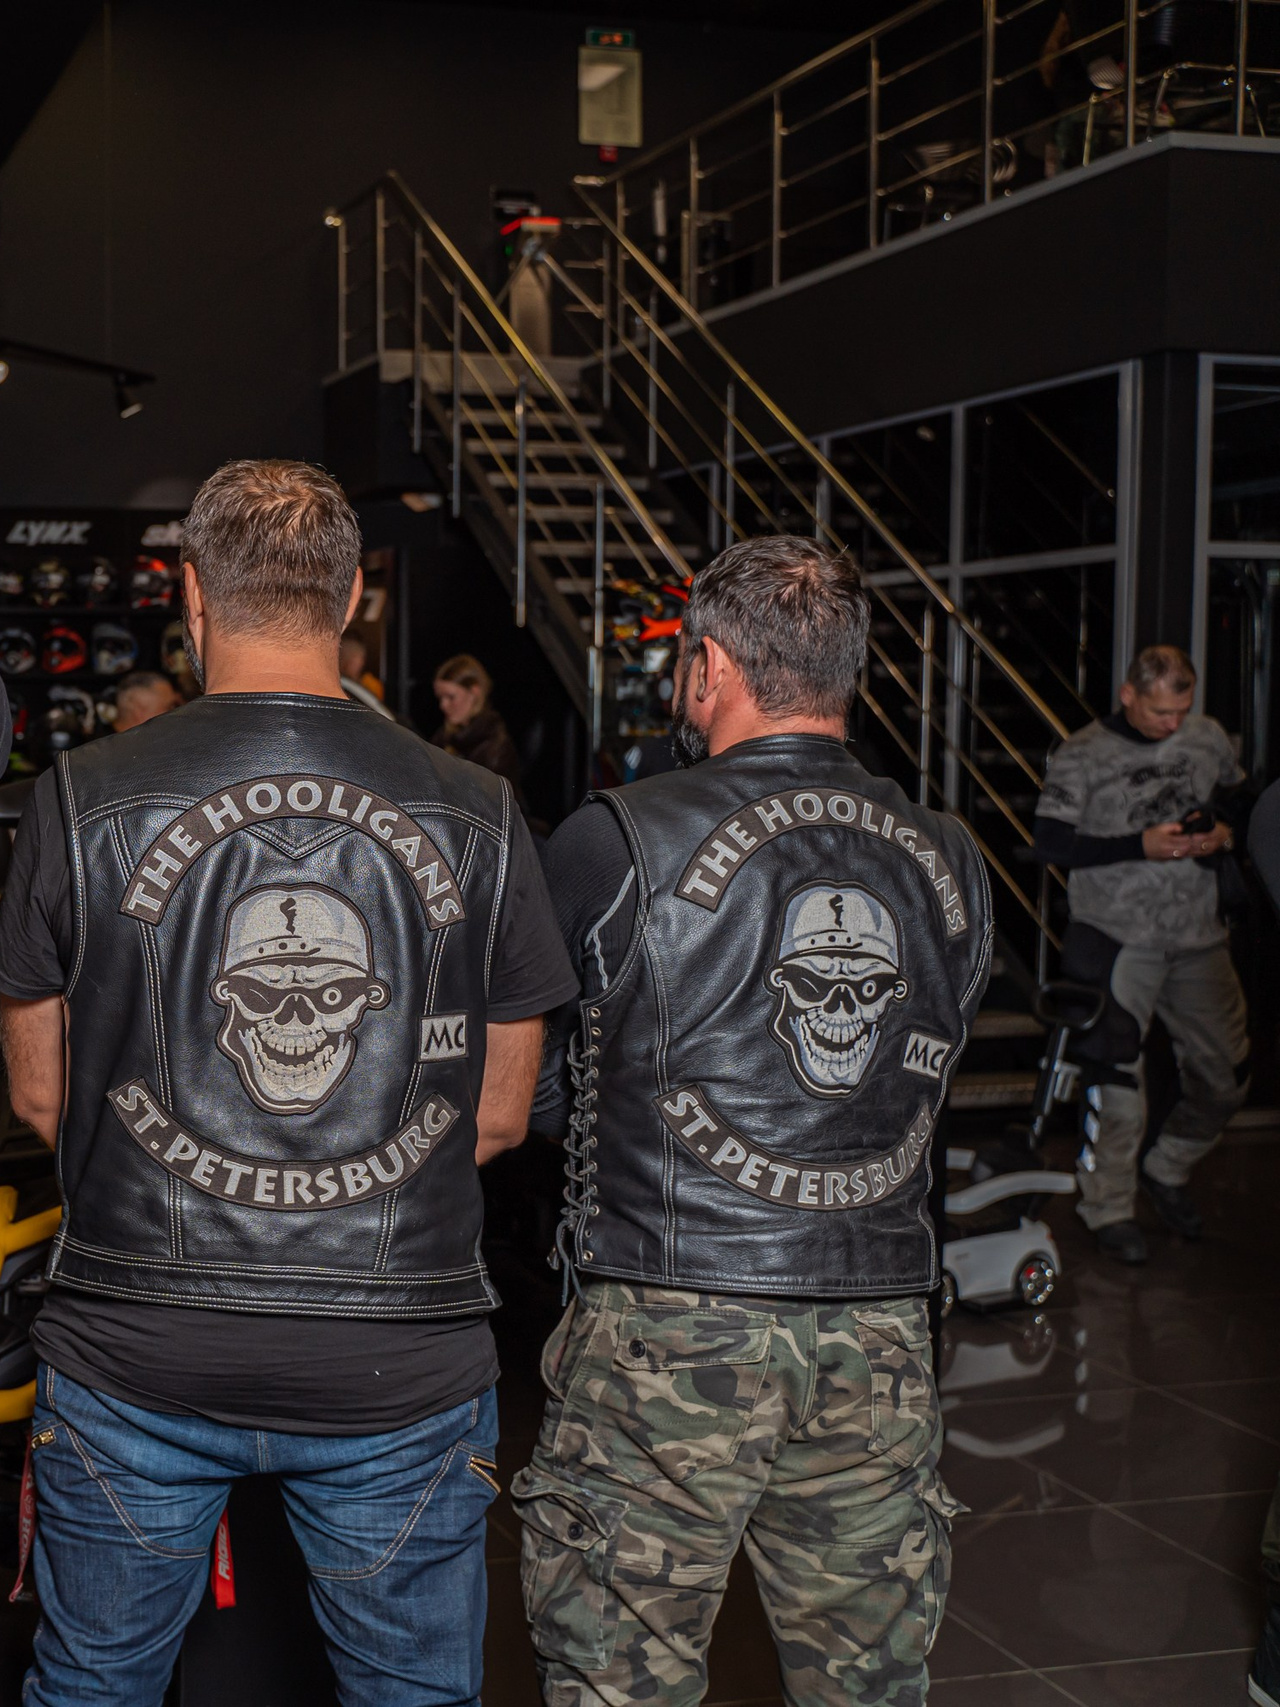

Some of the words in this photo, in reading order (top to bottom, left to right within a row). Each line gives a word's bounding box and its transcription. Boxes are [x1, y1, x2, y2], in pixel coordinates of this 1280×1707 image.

[127, 824, 203, 916] THE
[202, 780, 459, 924] HOOLIGANS
[683, 820, 758, 900] THE
[754, 793, 966, 933] HOOLIGANS
[423, 1019, 466, 1054] MC
[906, 1036, 945, 1075] MC
